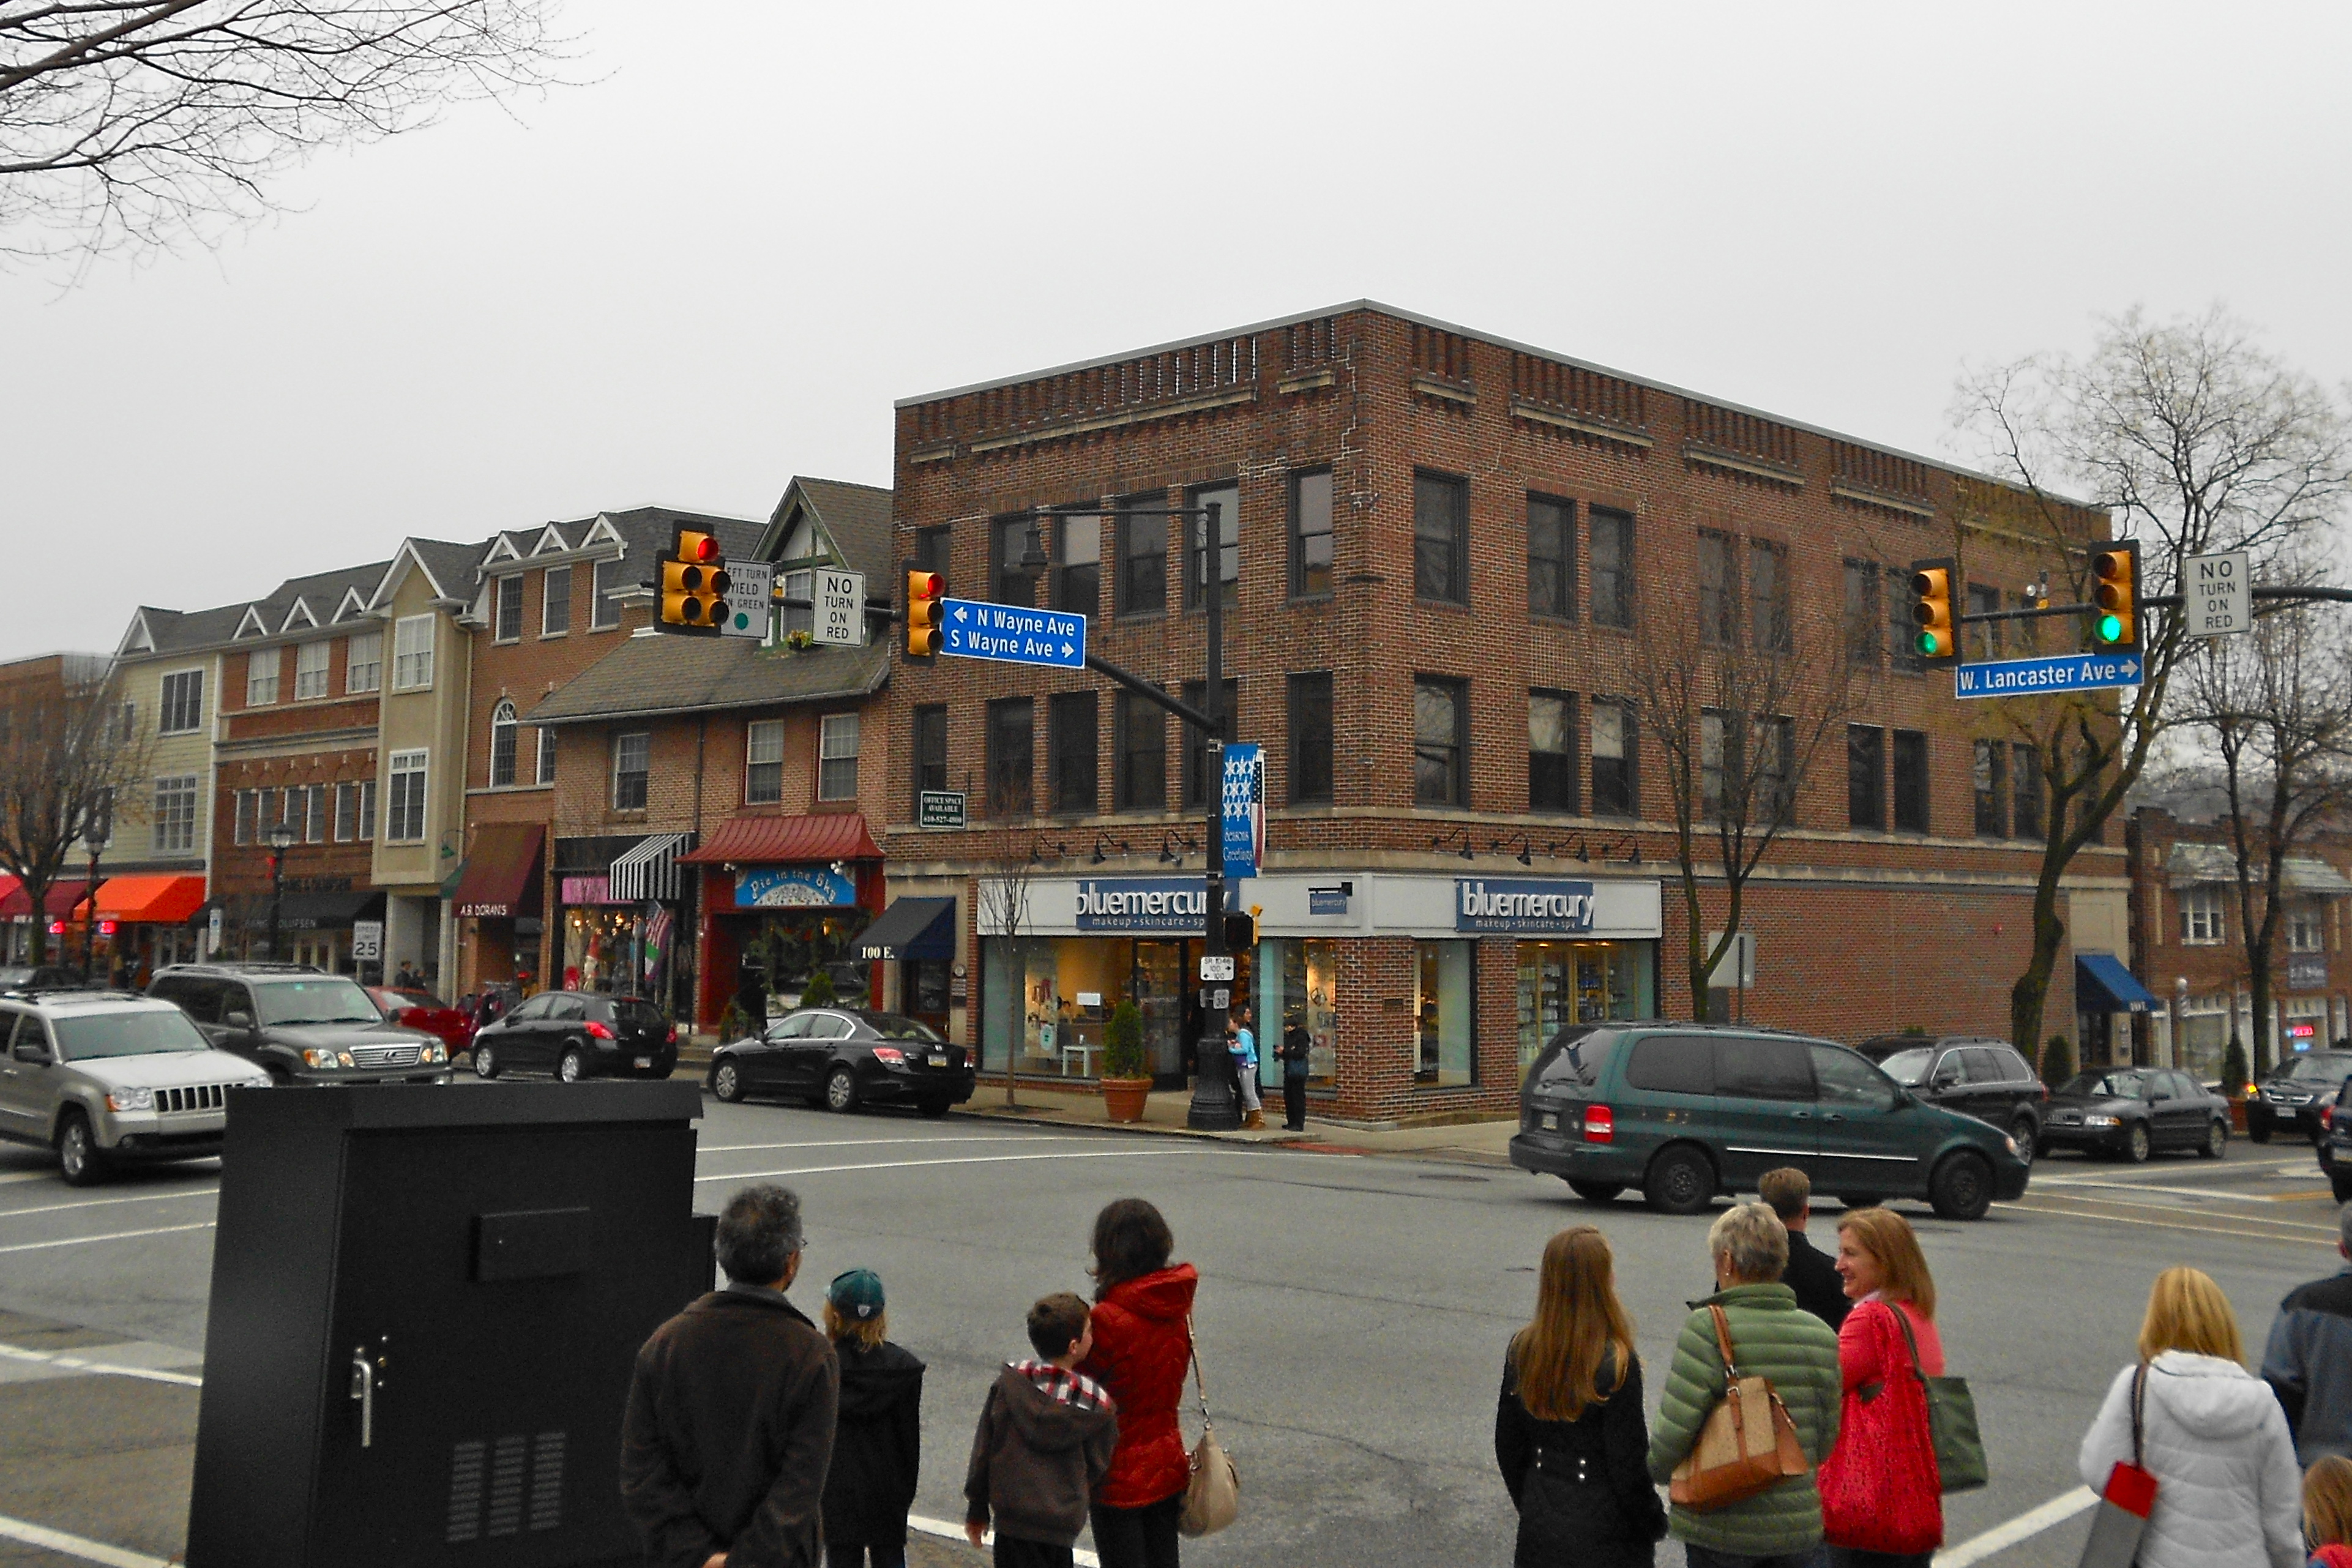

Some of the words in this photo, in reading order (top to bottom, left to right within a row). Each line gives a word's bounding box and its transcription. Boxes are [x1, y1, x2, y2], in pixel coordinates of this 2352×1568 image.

[726, 567, 742, 578] EFT
[746, 569, 767, 580] TURN
[2201, 561, 2233, 580] NO
[731, 582, 758, 595] YIELD
[827, 577, 852, 594] NO
[2198, 581, 2236, 596] TURN
[737, 599, 764, 610] GREEN
[824, 595, 854, 610] TURN
[2208, 599, 2228, 612] ON
[830, 611, 846, 624] ON
[977, 609, 988, 627] N
[994, 610, 1043, 635] Wayne
[1047, 617, 1075, 637] Ave
[2206, 614, 2233, 629] RED
[827, 626, 849, 640] RED
[950, 629, 960, 648] S
[968, 630, 1019, 655] Wayne
[1025, 638, 1053, 657] Ave
[1960, 671, 1979, 690] W.
[1986, 666, 2075, 689] Lancaster
[2081, 662, 2116, 681] Ave
[750, 879, 771, 900] Pie
[776, 870, 788, 881] in
[793, 870, 810, 881] the
[1463, 882, 1594, 926] bluemercury
[1092, 917, 1131, 928] makeup
[1140, 916, 1184, 926] skincare
[1193, 918, 1205, 928] sp
[1476, 919, 1510, 930] makeup
[1518, 918, 1555, 928] skincare
[1561, 920, 1576, 931] spa
[355, 942, 377, 955] 25
[862, 947, 881, 959] 100
[884, 947, 895, 959] E.
